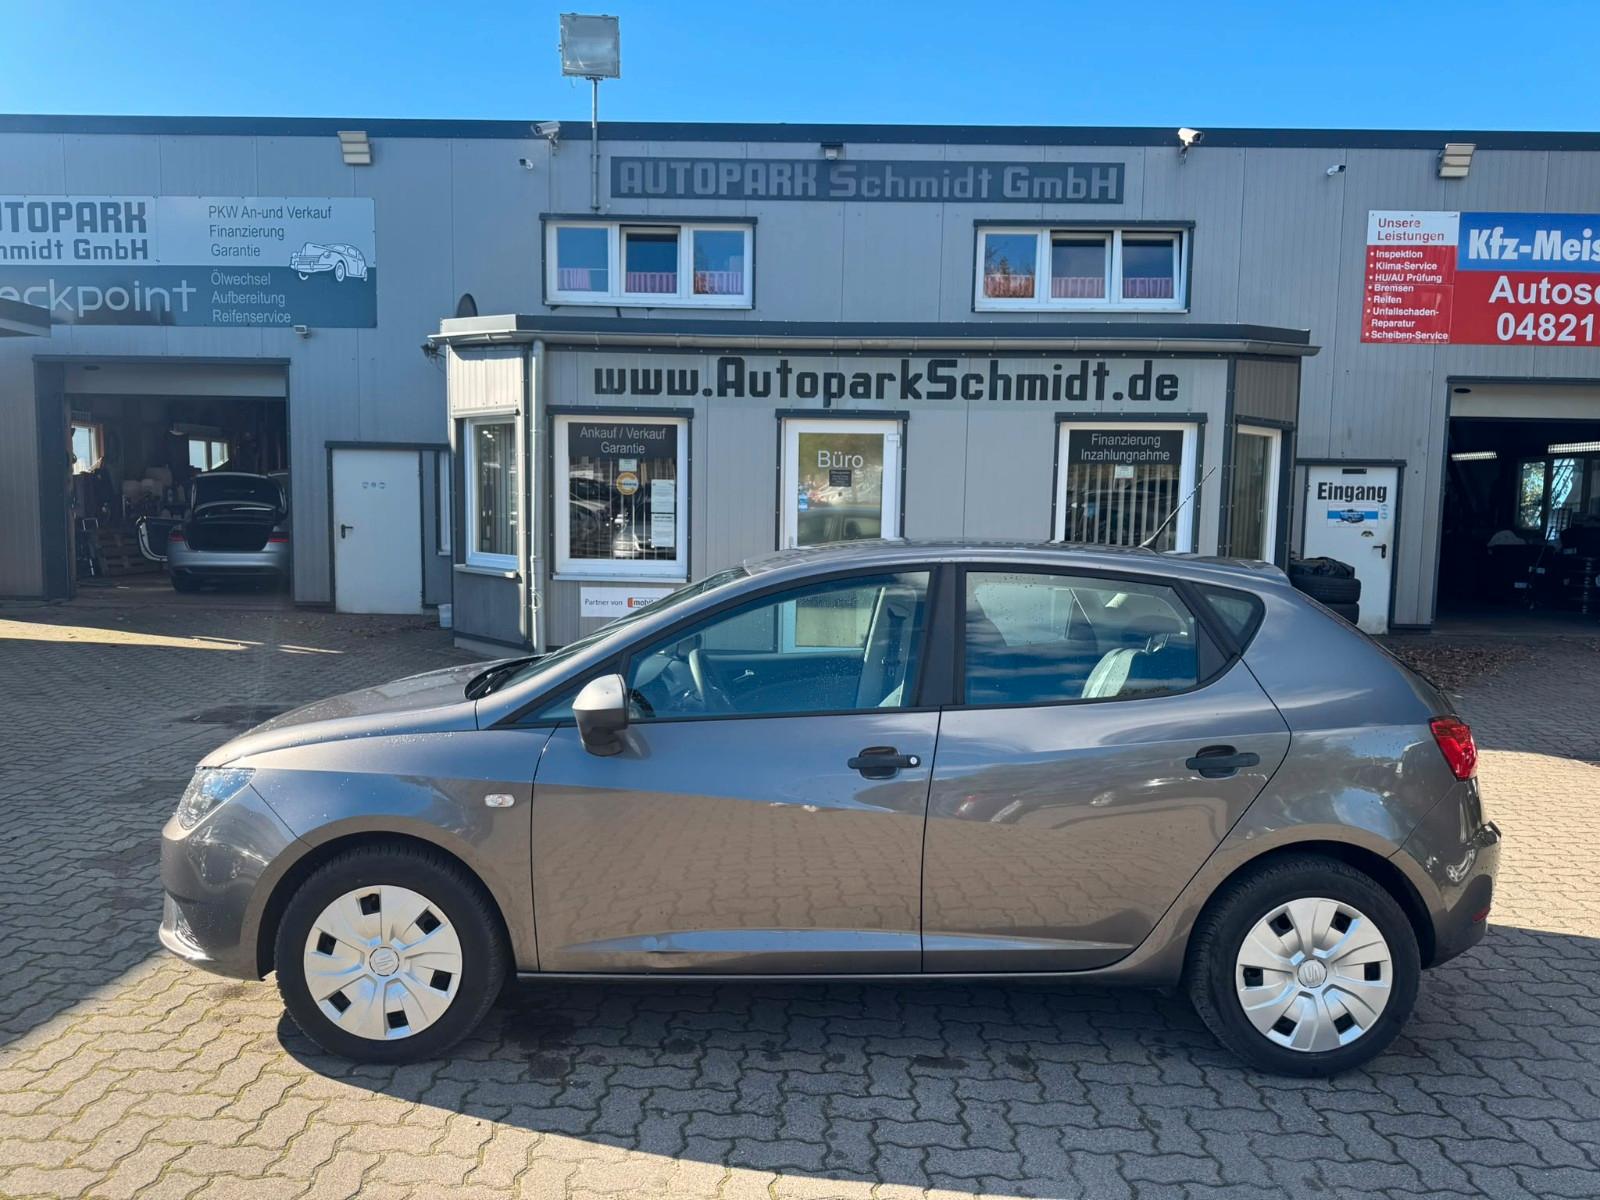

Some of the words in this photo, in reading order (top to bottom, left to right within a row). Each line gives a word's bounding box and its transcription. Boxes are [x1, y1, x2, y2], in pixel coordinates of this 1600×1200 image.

[619, 161, 817, 197] AUTOPARK
[828, 165, 992, 200] Schmidt
[1002, 166, 1117, 200] GmbH
[0, 201, 147, 233] TOPARK
[208, 205, 240, 219] PKW
[241, 205, 284, 220] An-und
[287, 206, 331, 220] Verkauf
[1378, 218, 1421, 228] Unsere
[209, 224, 285, 241] Finanzierung
[1377, 231, 1445, 243] Leistungen
[73, 239, 148, 260] GmbH
[211, 243, 261, 257] Garantie
[1376, 249, 1423, 261] Inspektion
[1376, 262, 1437, 271] Klima-Service
[210, 269, 271, 286] Ölwechsel
[1375, 274, 1404, 283] HU/AU
[1406, 273, 1442, 285] Prüfung
[1374, 284, 1414, 293] Bremsen
[211, 290, 286, 307] Aufbereitung
[1373, 295, 1402, 305] Reifen
[212, 309, 291, 324] Reifenservice
[1372, 307, 1440, 317] Unfallschaden-
[1371, 319, 1416, 330] Reparatur
[1496, 312, 1594, 342] 04821
[1370, 330, 1448, 341] Scheiben-Service
[594, 356, 1179, 407] www.AutoparkSchmidt.de
[579, 427, 617, 440] Ankauf
[627, 428, 666, 441] Verkauf
[1091, 433, 1161, 448] Finanzierung
[601, 441, 645, 454] Garantie
[817, 450, 864, 468] Büro
[1081, 448, 1170, 463] Inzahlungnahme
[1317, 482, 1387, 503] Eingang
[584, 598, 609, 606] Partner
